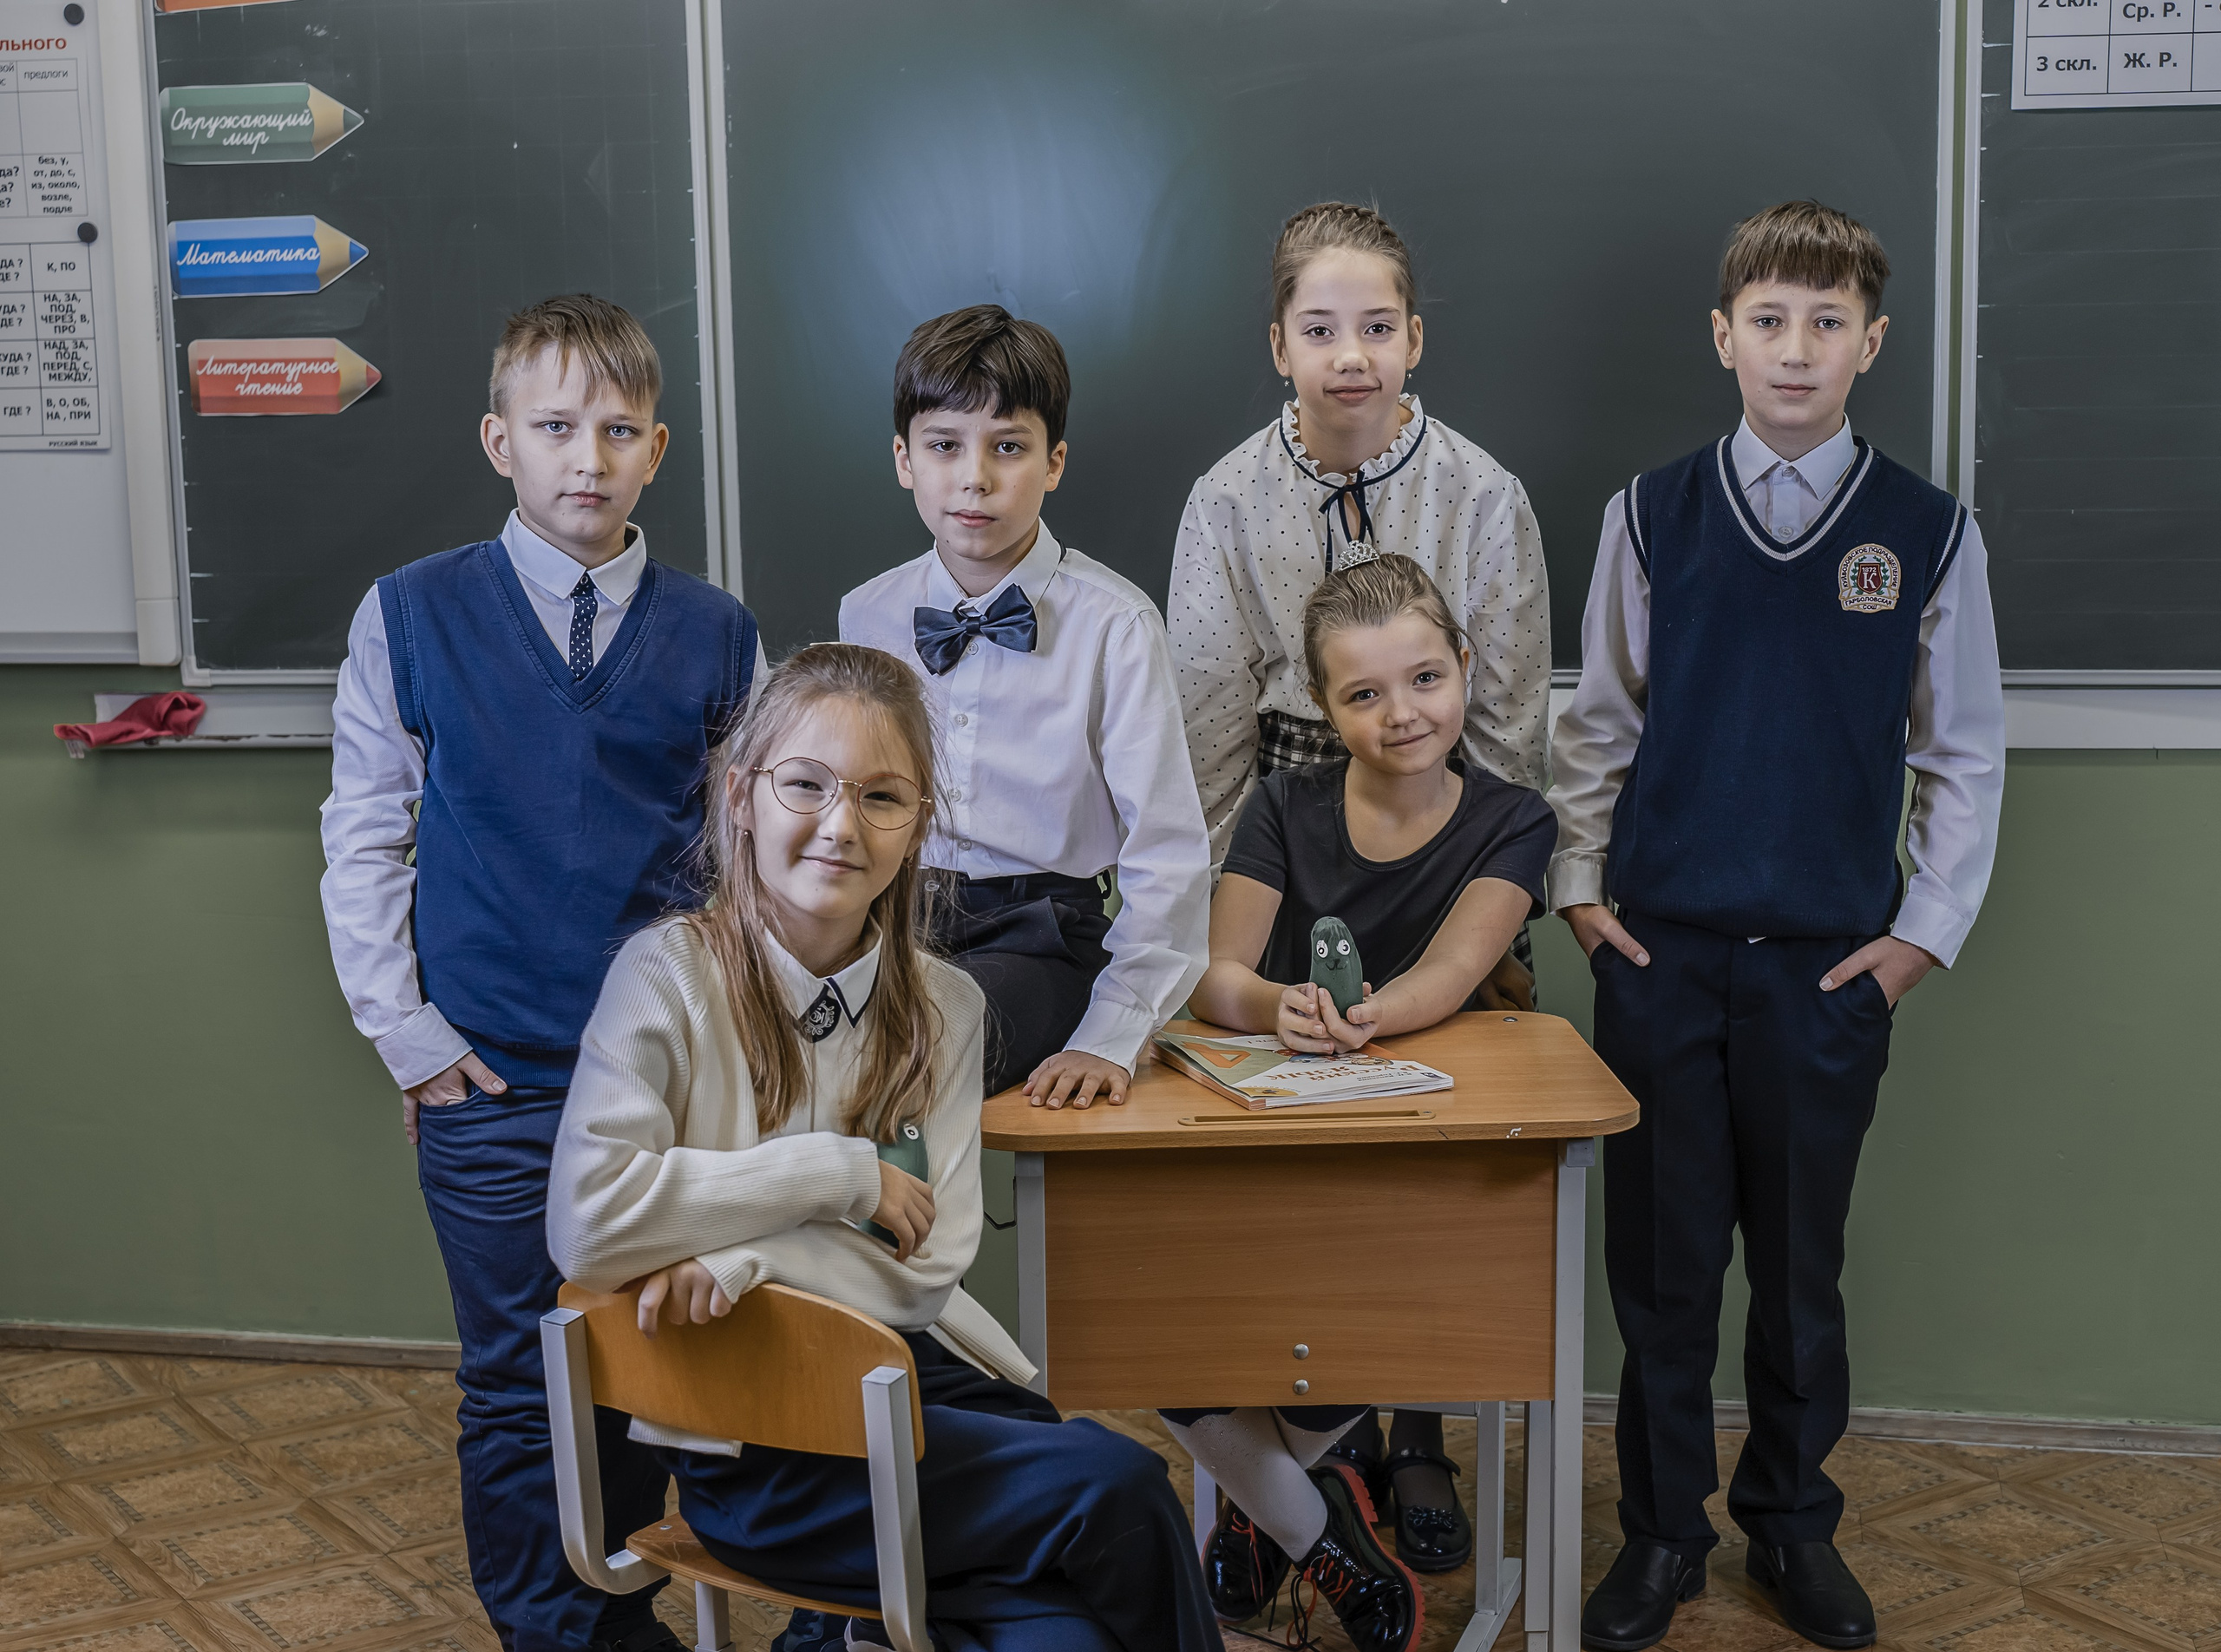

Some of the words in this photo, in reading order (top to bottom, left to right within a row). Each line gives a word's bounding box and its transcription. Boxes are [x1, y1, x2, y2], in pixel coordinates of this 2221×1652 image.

[2123, 3, 2155, 23] Ср.
[2162, 2, 2181, 17] Р.
[2036, 56, 2048, 71] 3
[2055, 59, 2097, 71] скл.
[2124, 52, 2151, 69] Ж.
[2159, 52, 2178, 68] Р.
[23, 69, 69, 81] предлоги
[170, 107, 313, 140] Окружающий
[223, 131, 270, 154] мир
[38, 155, 57, 166] без,
[61, 157, 69, 166] у,
[34, 169, 47, 178] от,
[50, 168, 65, 178] до,
[68, 168, 75, 178] с,
[48, 180, 80, 190] около,
[42, 193, 72, 202] возле,
[43, 206, 73, 214] подле
[176, 243, 320, 266] Математика
[47, 262, 57, 273] К,
[61, 261, 75, 272] ПО
[43, 293, 62, 304] НА,
[64, 292, 81, 303] ЗА,
[50, 304, 76, 314] ПОД,
[41, 313, 76, 324] ЧЕРЕЗ,
[81, 313, 90, 324] В,
[54, 324, 75, 335] ПРО
[44, 340, 69, 351] НАД,
[72, 339, 88, 350] ЗА,
[56, 351, 82, 362] ПОД,
[1, 365, 20, 377] ГДЕ
[43, 361, 80, 372] ПЕРЕД,
[82, 361, 93, 372] С,
[196, 355, 340, 382] Литературное
[49, 371, 91, 383] МЕЖДУ,
[234, 379, 304, 396] чтение
[46, 398, 56, 409] В,
[59, 397, 69, 409] О,
[72, 397, 90, 408] ОБ,
[3, 406, 23, 417] ГДЕ
[69, 410, 91, 421] ПРИ
[1868, 547, 1898, 587] ПОДРАЗДЕЛЕНИЕ
[1845, 596, 1892, 606] ГАРБОЛОВСКАЯ
[1307, 1064, 1422, 1082] Русский
